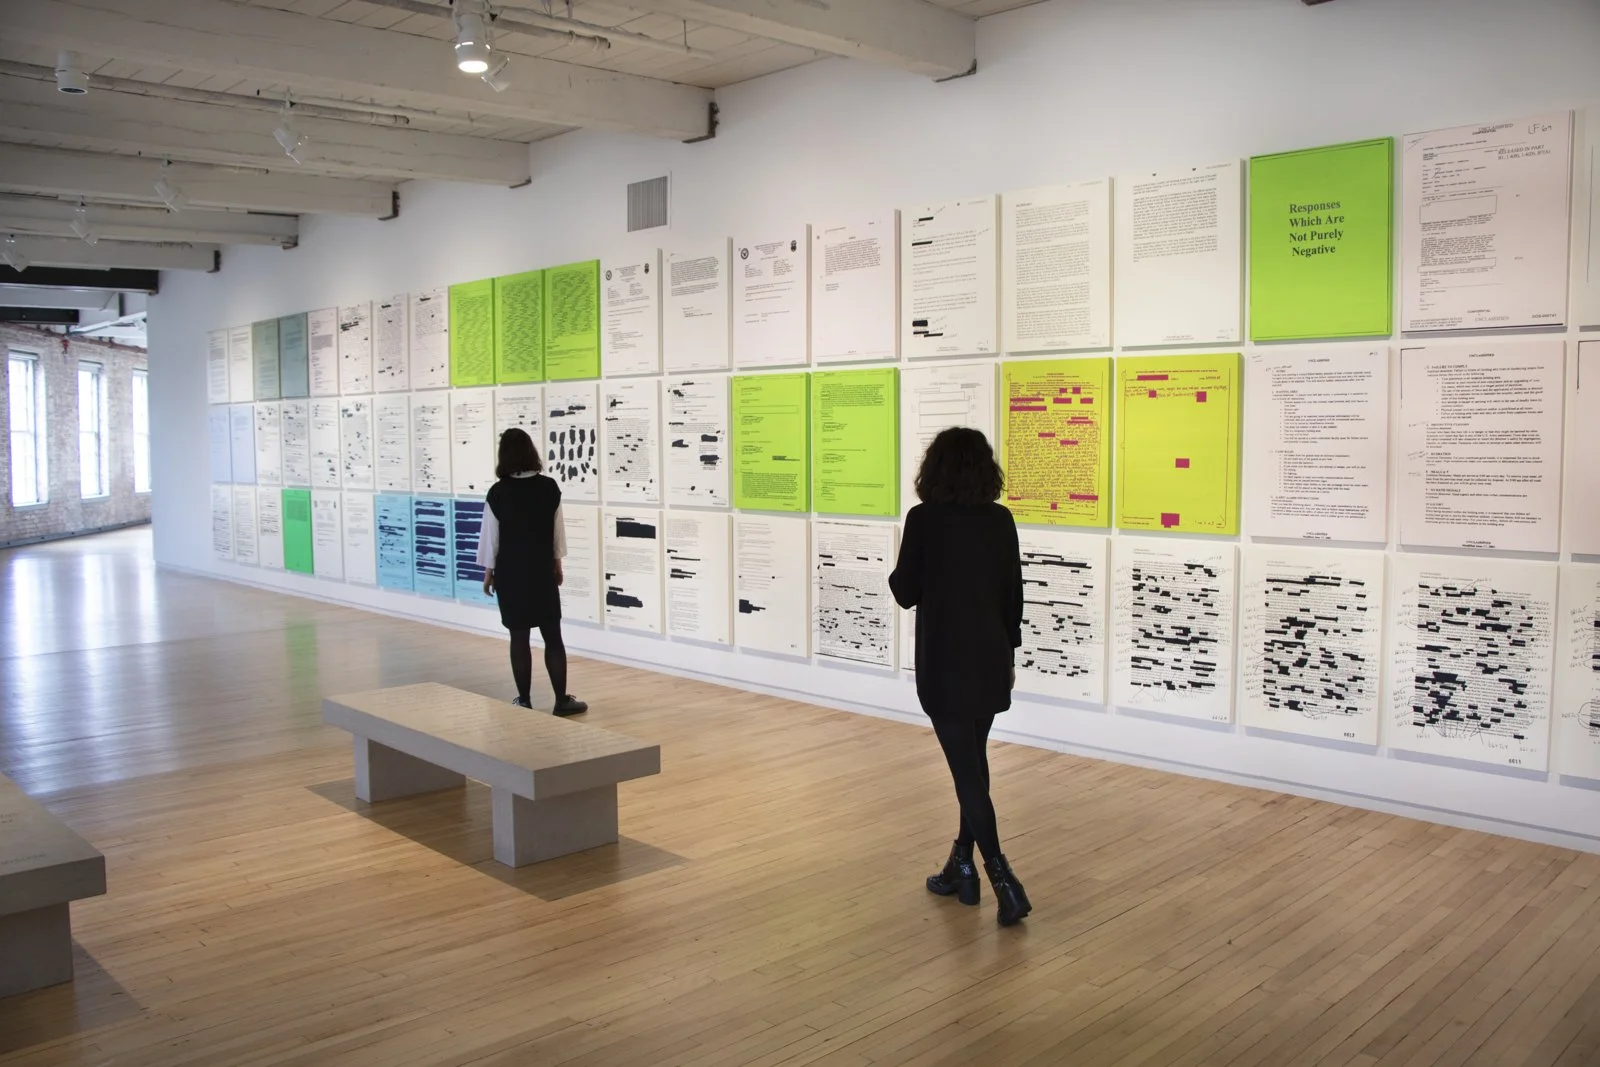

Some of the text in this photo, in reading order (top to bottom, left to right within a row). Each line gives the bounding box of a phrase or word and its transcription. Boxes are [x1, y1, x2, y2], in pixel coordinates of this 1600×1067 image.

[1289, 201, 1342, 214] Responses
[1289, 215, 1345, 228] Which Are
[1289, 229, 1344, 243] Not Purely
[1292, 244, 1337, 258] Negative
